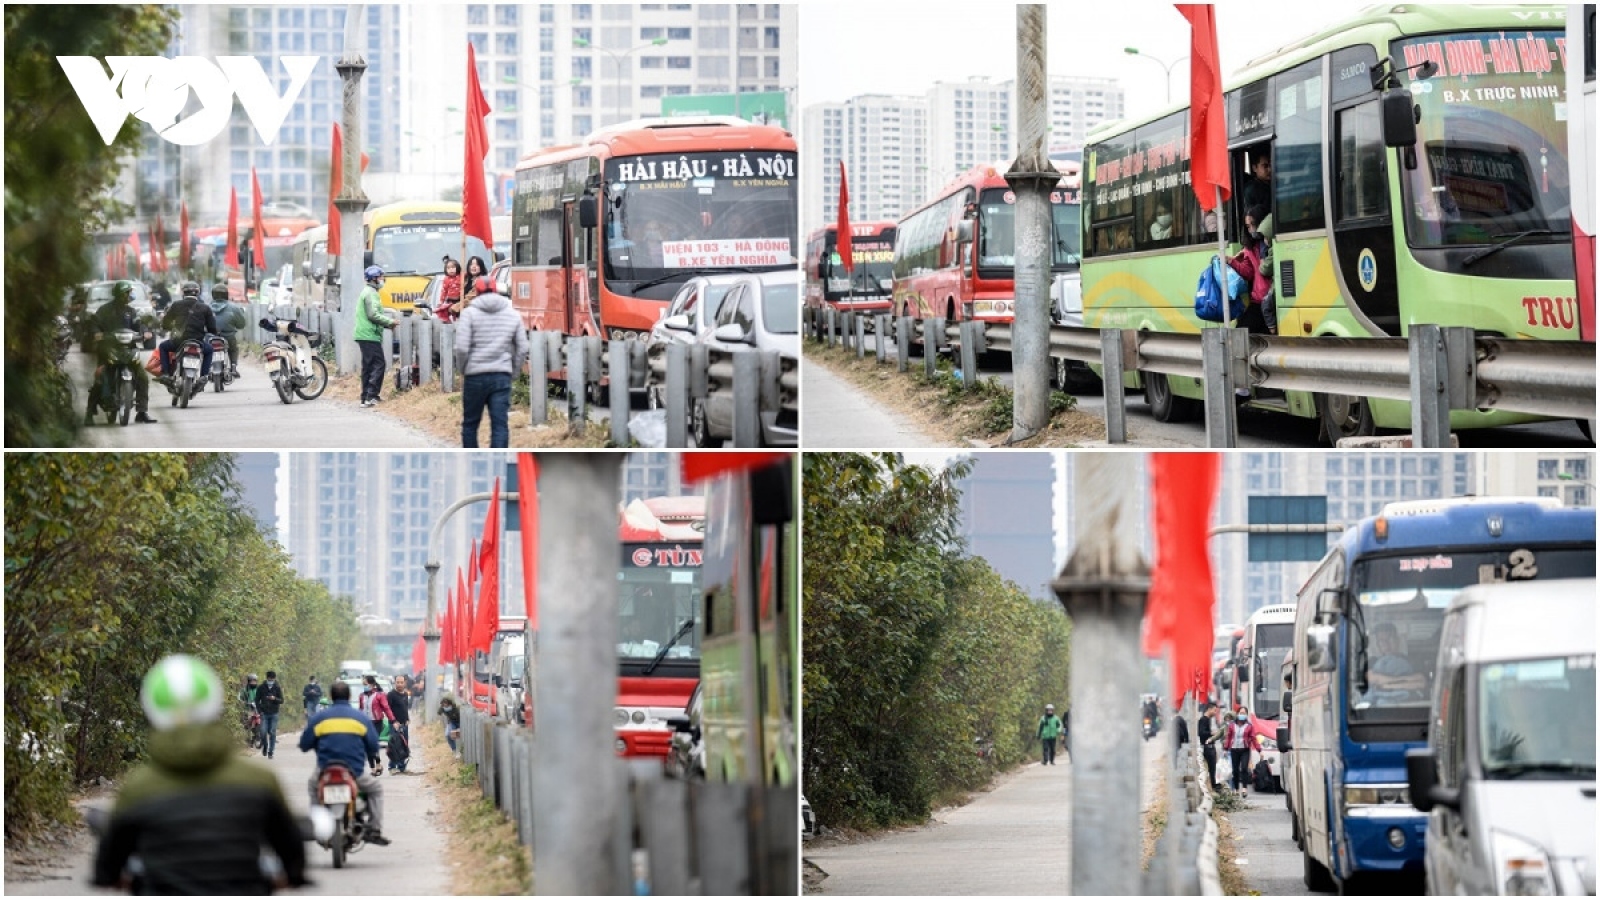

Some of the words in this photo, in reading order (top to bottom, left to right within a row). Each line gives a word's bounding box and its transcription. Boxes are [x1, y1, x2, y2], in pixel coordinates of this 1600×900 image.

[1403, 41, 1447, 80] NAM
[1444, 39, 1488, 82] ĐỊNH
[1489, 31, 1520, 73] HẢI
[1516, 31, 1552, 79] HẬU
[1341, 62, 1365, 80] SAMCO
[1443, 90, 1472, 103] B.X
[1474, 85, 1518, 103] TRỰC
[1519, 85, 1560, 99] NINH
[619, 156, 657, 181] HẢI
[662, 155, 708, 181] HẬU
[722, 153, 754, 177] HÀ
[757, 153, 794, 180] NỘI
[852, 226, 875, 237] VIP
[664, 241, 693, 254] VIỆN
[697, 243, 719, 253] 103
[735, 240, 752, 251] HÀ
[755, 239, 789, 251] ĐÔNG
[678, 256, 707, 267] B.XE
[710, 254, 735, 266] YÊN
[739, 254, 777, 266] NGHĨA
